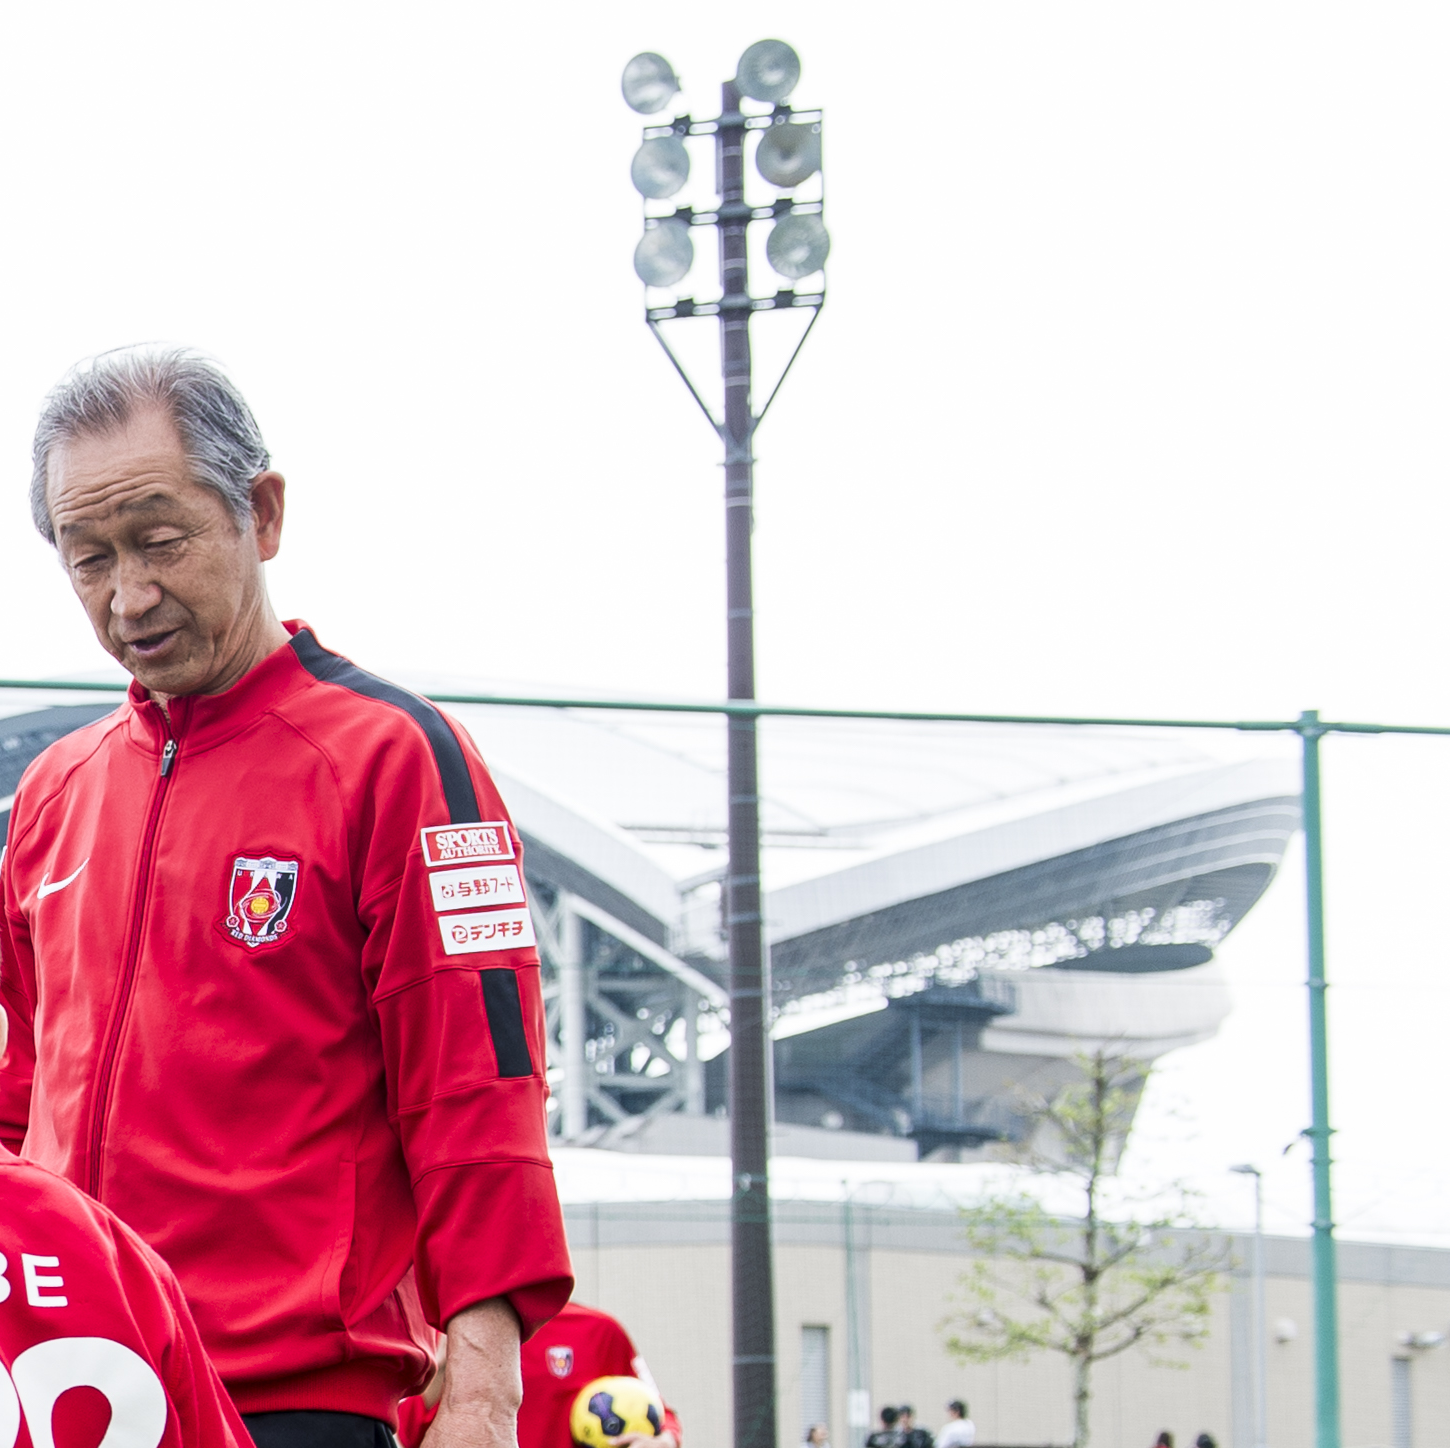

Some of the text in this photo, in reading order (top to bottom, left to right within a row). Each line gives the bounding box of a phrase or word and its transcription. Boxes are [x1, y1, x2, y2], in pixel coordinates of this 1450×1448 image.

[435, 828, 498, 850] SPORTS
[457, 876, 514, 897] 与野フード
[470, 920, 523, 941] デンキチ
